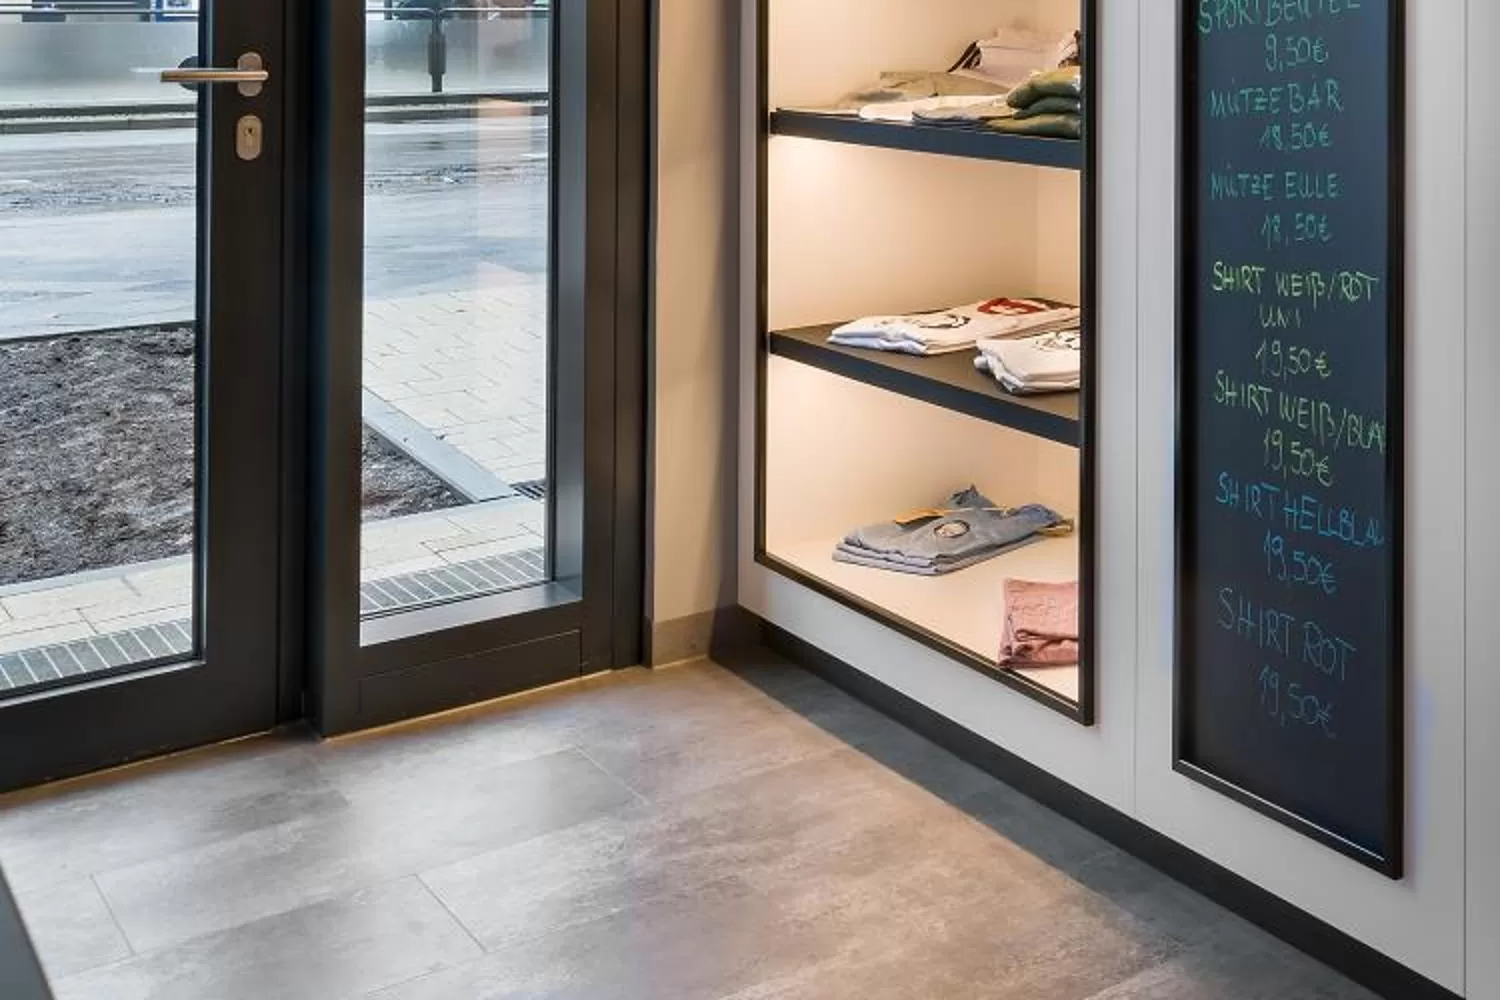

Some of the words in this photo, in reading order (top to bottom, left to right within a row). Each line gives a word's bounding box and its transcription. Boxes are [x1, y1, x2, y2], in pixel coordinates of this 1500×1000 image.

[1211, 261, 1266, 295] SHIRT
[1255, 337, 1332, 384] 19,50€
[1214, 368, 1273, 418] SHIRT
[1263, 427, 1333, 487] 19,50€
[1215, 471, 1281, 522] SHIRT
[1263, 528, 1337, 595] 19,50€
[1216, 586, 1296, 658] SHIRT
[1303, 620, 1358, 681] ROT
